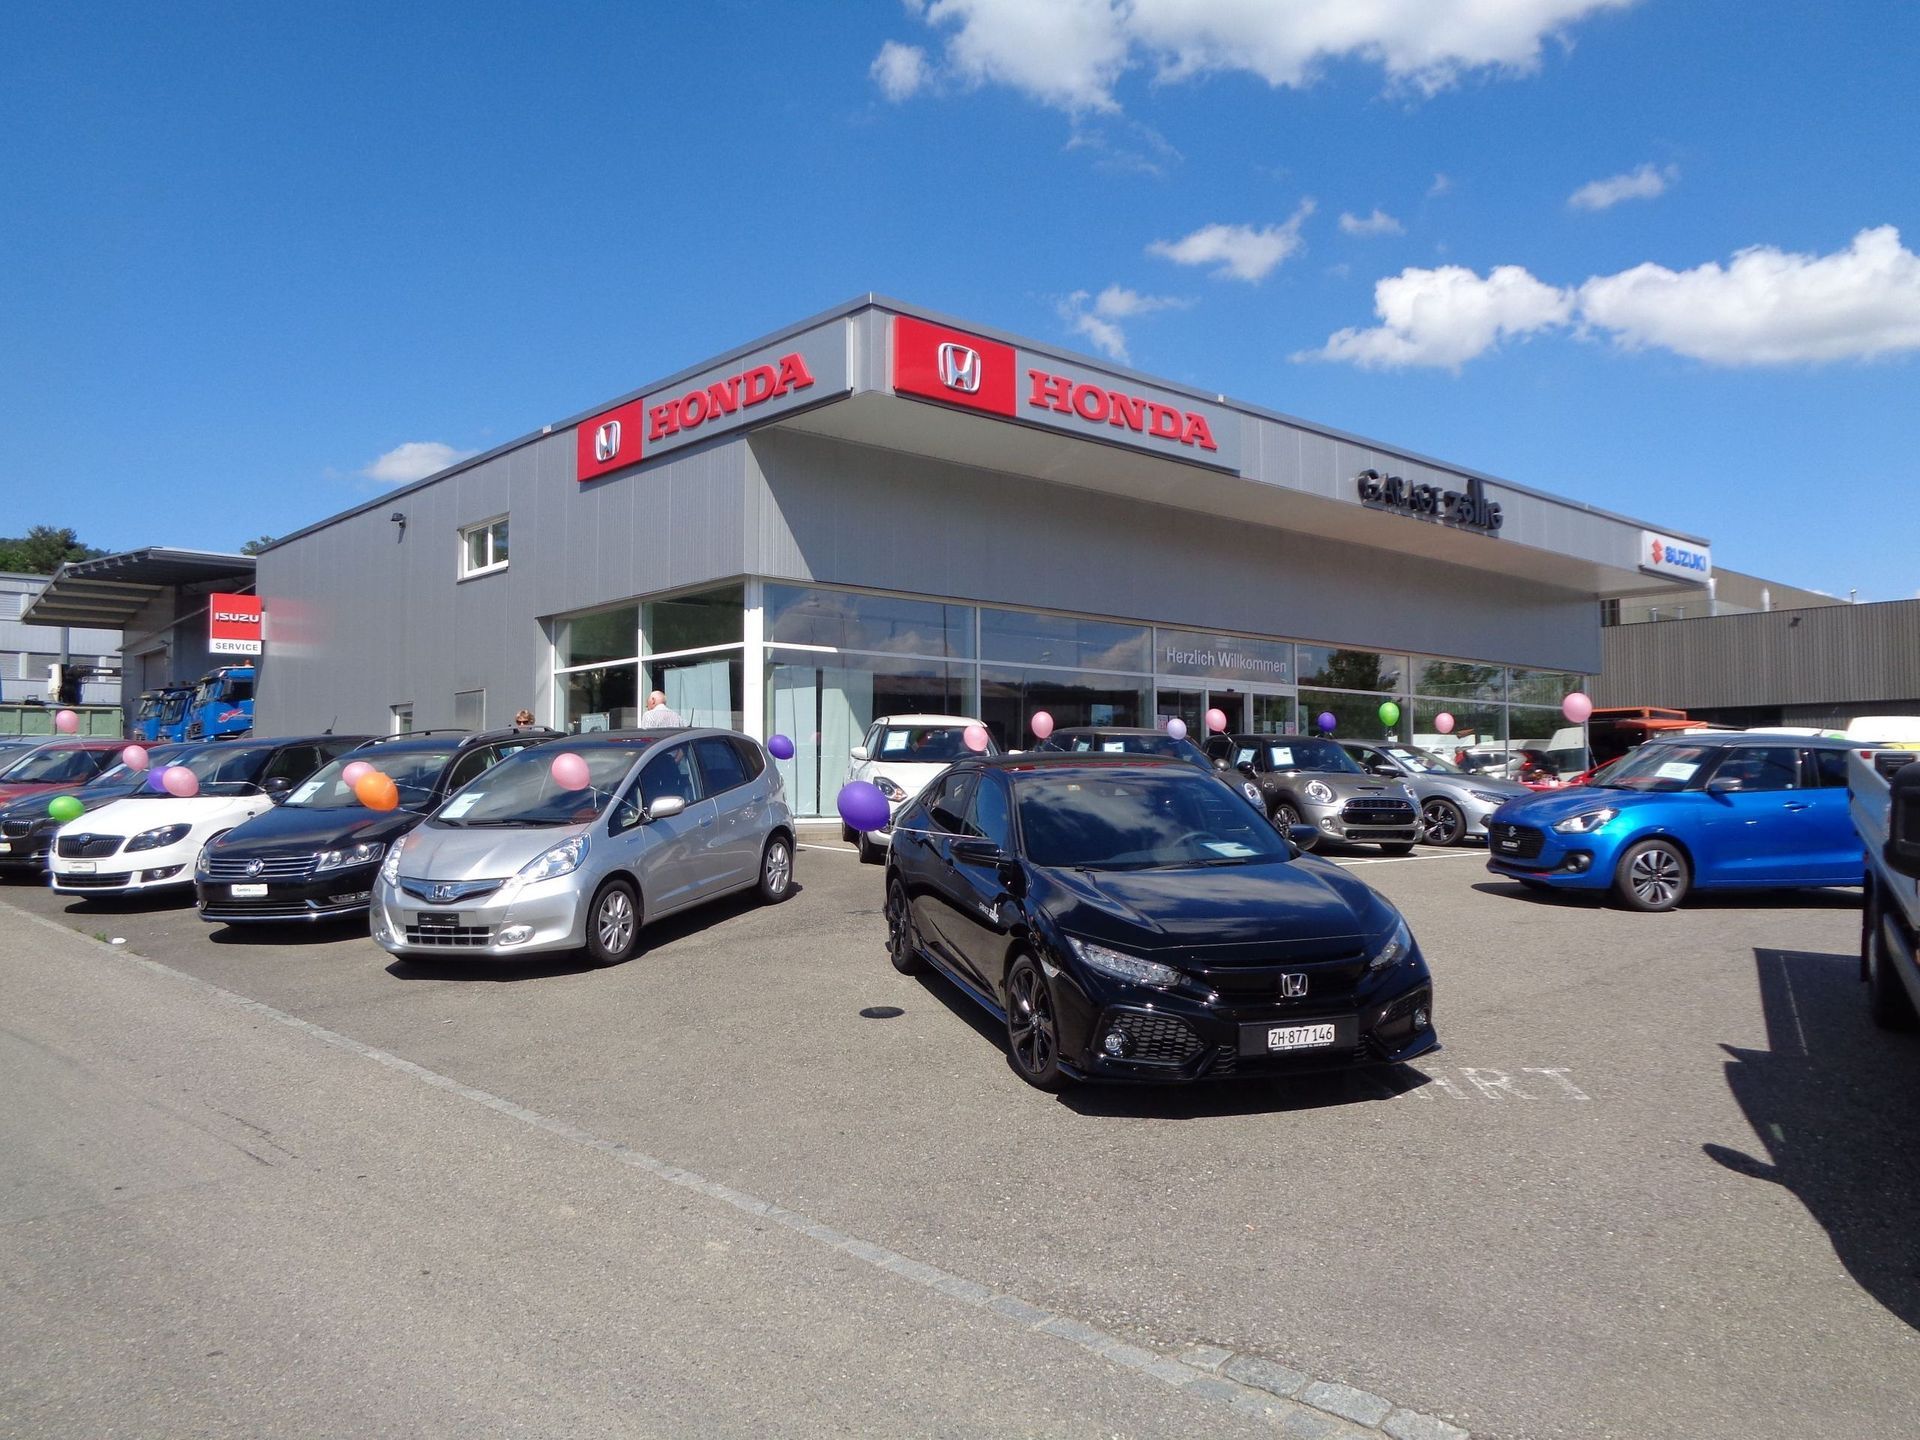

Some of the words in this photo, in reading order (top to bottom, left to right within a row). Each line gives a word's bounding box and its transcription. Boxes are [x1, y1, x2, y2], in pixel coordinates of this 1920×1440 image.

[649, 352, 815, 441] HONDA
[1028, 368, 1218, 452] HONDA
[1665, 545, 1706, 572] SUZUKI
[215, 612, 260, 623] ISUZU
[215, 642, 259, 652] SERVICE
[1166, 647, 1215, 666] Herzlich
[1217, 651, 1287, 673] Willkommen
[1312, 1026, 1333, 1042] 146
